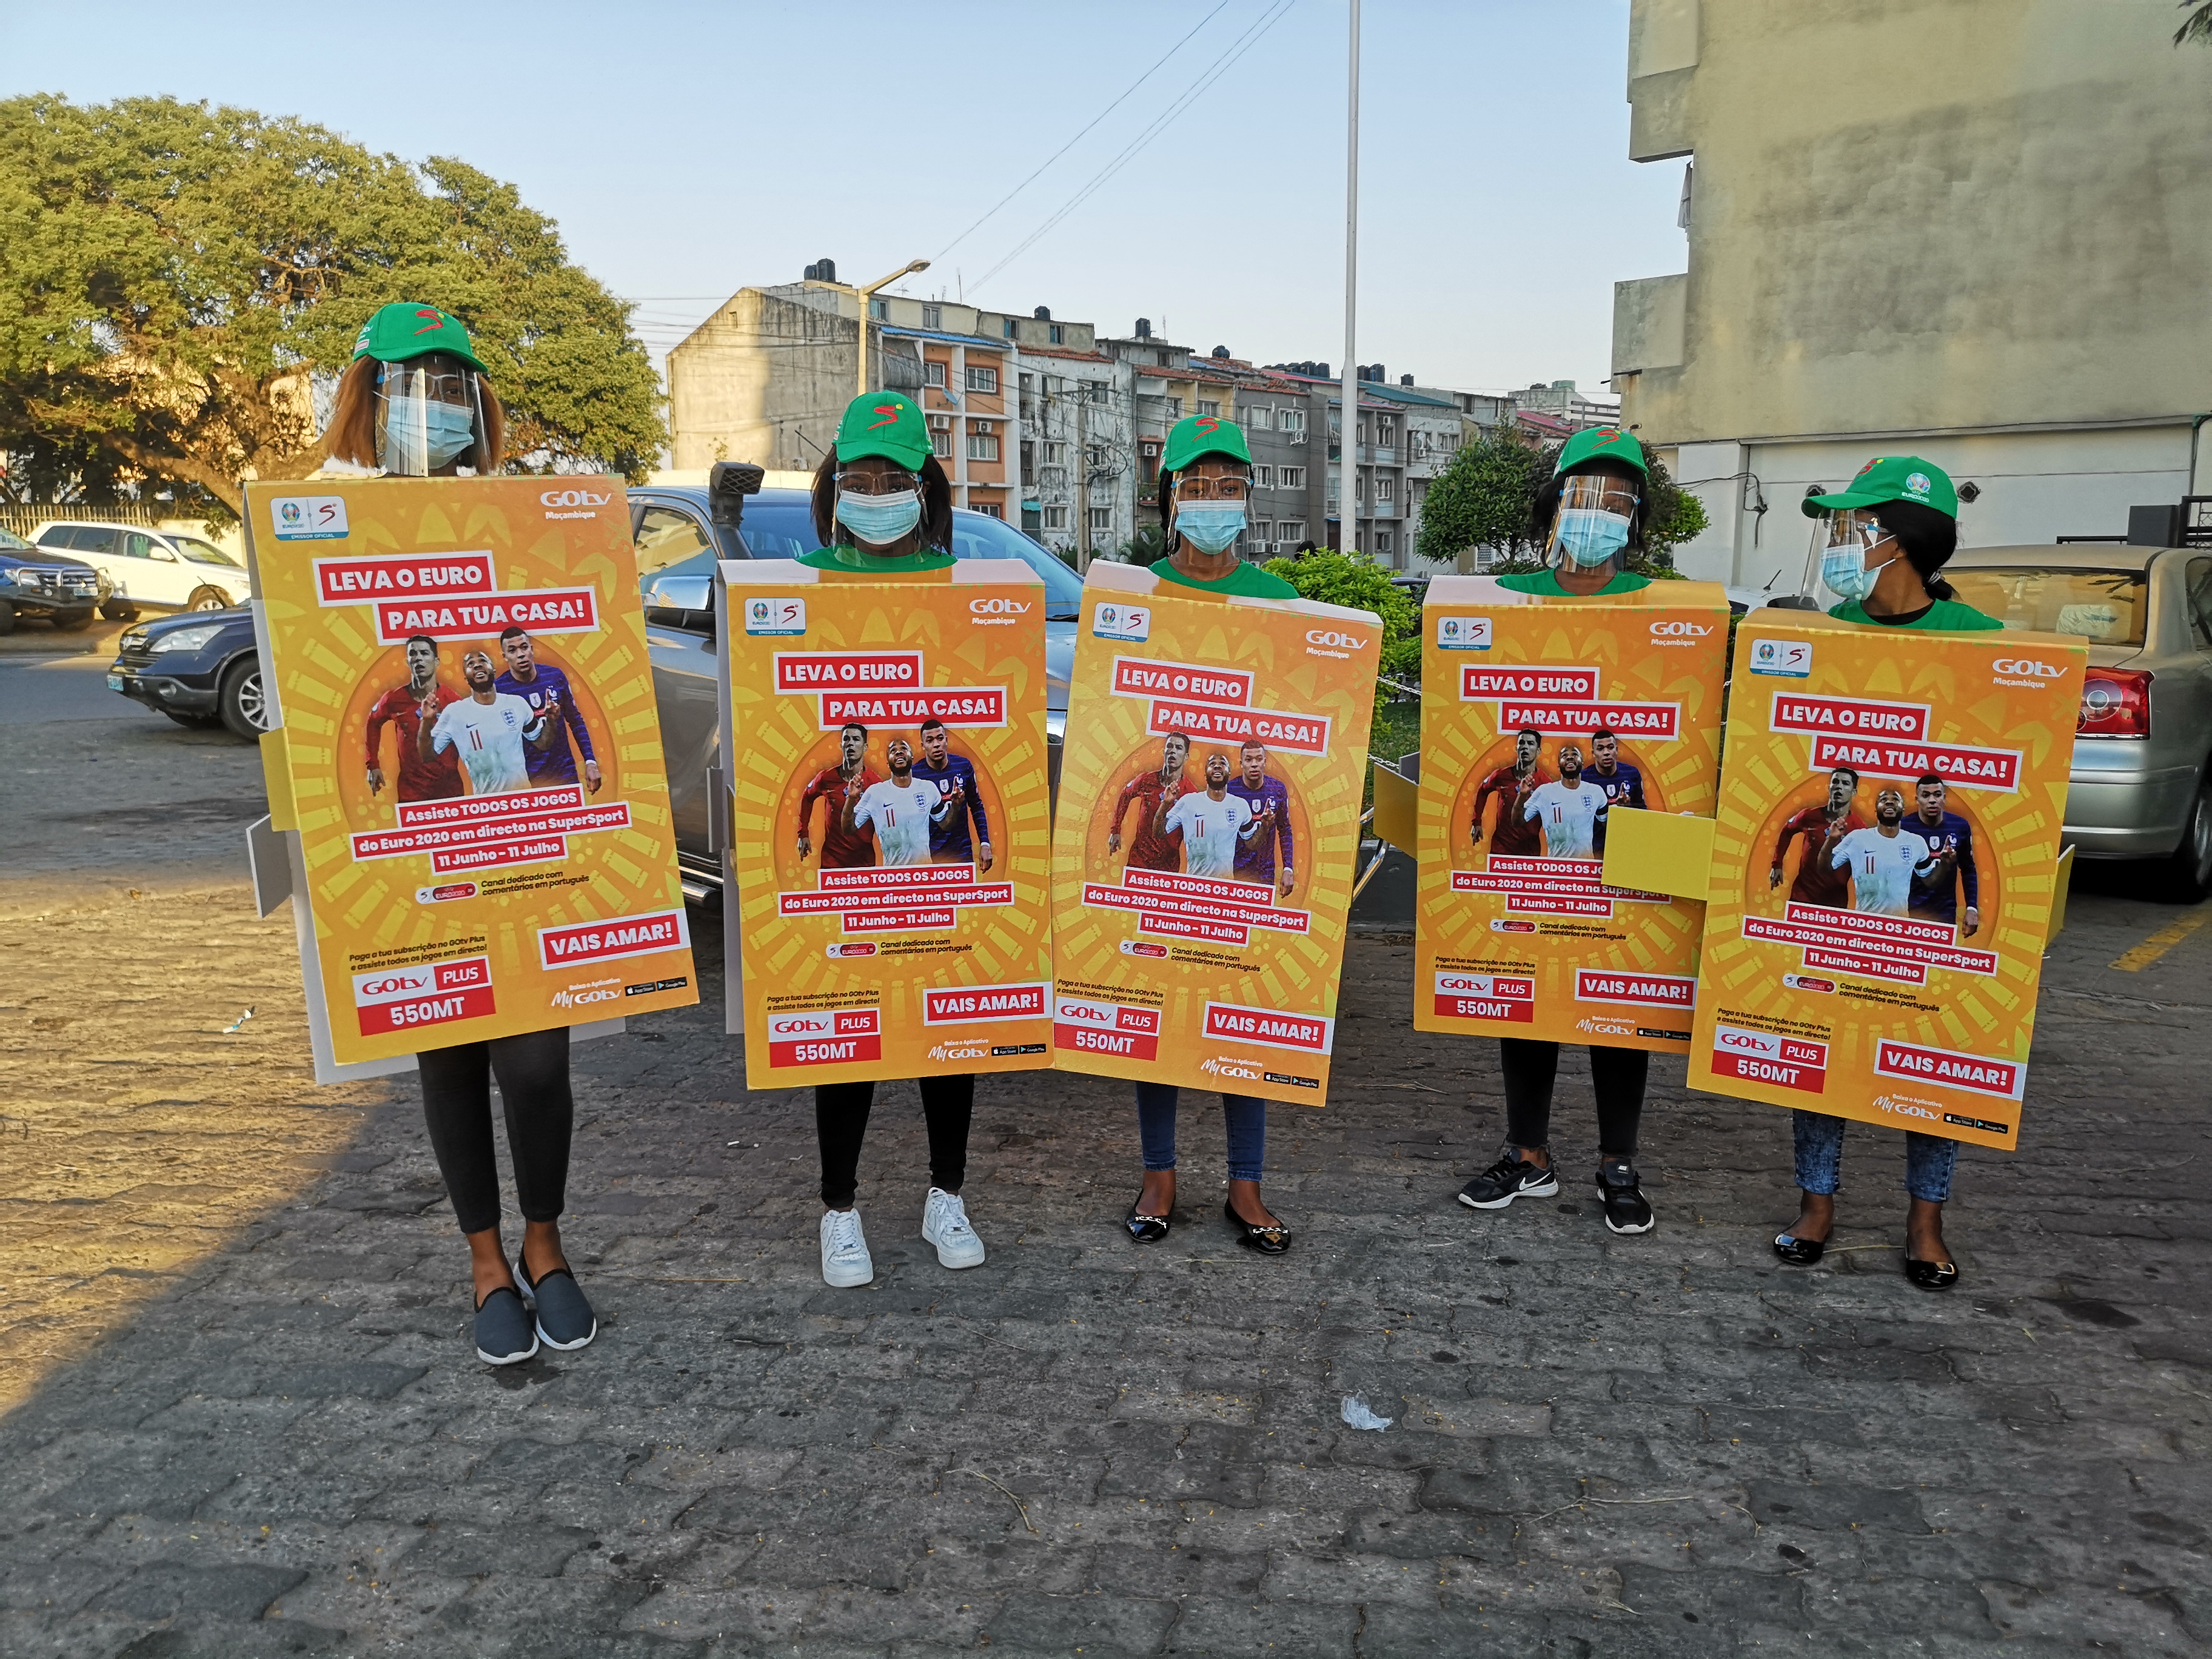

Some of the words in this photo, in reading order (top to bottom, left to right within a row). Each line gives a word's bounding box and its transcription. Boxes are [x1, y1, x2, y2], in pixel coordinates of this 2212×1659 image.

[541, 491, 611, 507] GOtv
[546, 511, 595, 520] Moçambique
[329, 571, 394, 591] LEVA
[397, 569, 415, 587] O
[418, 566, 482, 586] EURO
[388, 609, 457, 630] PARA
[458, 605, 508, 625] TUA
[511, 599, 585, 622] CASA!
[970, 599, 1031, 613] GOtv
[1649, 622, 1714, 635] GOtv
[1306, 631, 1367, 649] GOtv
[1306, 648, 1349, 659] Moçambique
[786, 665, 837, 681] LEVA
[840, 665, 856, 680] O
[860, 663, 912, 680] EURO
[1992, 659, 2068, 677] GOtv
[1122, 669, 1170, 689] LEVA
[1173, 675, 1188, 691] O
[1191, 677, 1241, 697] EURO
[1470, 676, 1517, 691] LEVA
[1521, 677, 1534, 691] O
[1538, 678, 1588, 692] EURO
[1993, 677, 2045, 689] Moçambique
[830, 701, 886, 717] PARA
[888, 700, 930, 716] TUA
[933, 697, 995, 715] CASA!
[1158, 709, 1210, 729] PARA
[1215, 716, 1252, 735] TUA
[1256, 722, 1318, 743] CASA!
[1509, 709, 1560, 725] PARA
[1563, 711, 1602, 726] TUA
[1606, 712, 1667, 728] CASA!
[1783, 705, 1834, 724] LEVA
[1839, 710, 1855, 726] O
[1858, 712, 1916, 731] EURO
[1822, 744, 1881, 765] PARA
[1886, 751, 1929, 770] TUA
[1934, 756, 2007, 778] CASA!
[406, 807, 459, 822] Assiste
[460, 800, 509, 815] TODOS
[511, 798, 529, 809] OS
[531, 793, 577, 807] JOGOS
[360, 840, 378, 852] do
[380, 838, 414, 850] Euro
[416, 831, 449, 845] 2020
[452, 830, 475, 840] em
[477, 823, 526, 837] directo
[529, 821, 547, 831] na
[548, 810, 624, 830] SuperSport
[438, 855, 451, 866] 11
[452, 851, 497, 865] Junho
[508, 846, 519, 857] 11
[521, 843, 560, 856] Julho
[481, 878, 505, 887] Canal
[507, 873, 544, 884] dedicado
[483, 883, 534, 896] comentários
[549, 875, 589, 889] português
[825, 874, 870, 885] Assiste
[871, 873, 911, 883] TODOS
[913, 872, 928, 881] OS
[930, 870, 970, 880] JOGOS
[785, 899, 800, 909] do
[803, 899, 830, 908] Euro
[831, 896, 859, 906] 2020
[882, 893, 924, 903] directo
[943, 889, 1008, 903] SuperSport
[1521, 899, 1556, 908] Junho
[1566, 901, 1574, 910] 11
[1575, 902, 1607, 912] Julho
[848, 917, 857, 927] 11
[859, 916, 896, 926] Junho
[907, 914, 916, 923] 11
[917, 913, 950, 923] Julho
[394, 943, 437, 954] subscrição
[551, 934, 601, 955] VAIS
[605, 922, 672, 948] AMAR!
[1749, 923, 1764, 933] do
[1766, 925, 1794, 937] Euro
[1795, 930, 1824, 942] 2020
[1826, 936, 1846, 946] em
[1848, 937, 1894, 953] directo
[1896, 947, 1913, 956] na
[1915, 948, 1990, 968] SuperSport
[363, 977, 427, 994] GOtv
[443, 967, 478, 984] PLUS
[1091, 984, 1125, 993] subscrição
[1441, 979, 1488, 990] GOtv
[1499, 984, 1526, 994] PLUS
[1585, 979, 1625, 993] VAIS
[1627, 982, 1687, 999] AMAR!
[390, 997, 464, 1025] 550MT
[933, 997, 975, 1013] VAIS
[979, 993, 1037, 1011] AMAR!
[1458, 1000, 1512, 1017] 550MT
[775, 1020, 828, 1033] GOtv
[841, 1017, 870, 1029] PLUS
[1061, 1005, 1111, 1021] GOtv
[1122, 1014, 1151, 1027] PLUS
[1214, 1013, 1255, 1032] VAIS
[1257, 1021, 1318, 1041] AMAR!
[796, 1042, 856, 1061] 550MT
[1076, 1031, 1134, 1053] 550MT
[1721, 1034, 1774, 1051] GOtv
[1786, 1046, 1817, 1060] PLUS
[1738, 1059, 1800, 1084] 550MT
[1887, 1051, 1934, 1072] VAIS
[1936, 1061, 2007, 1086] AMAR!
